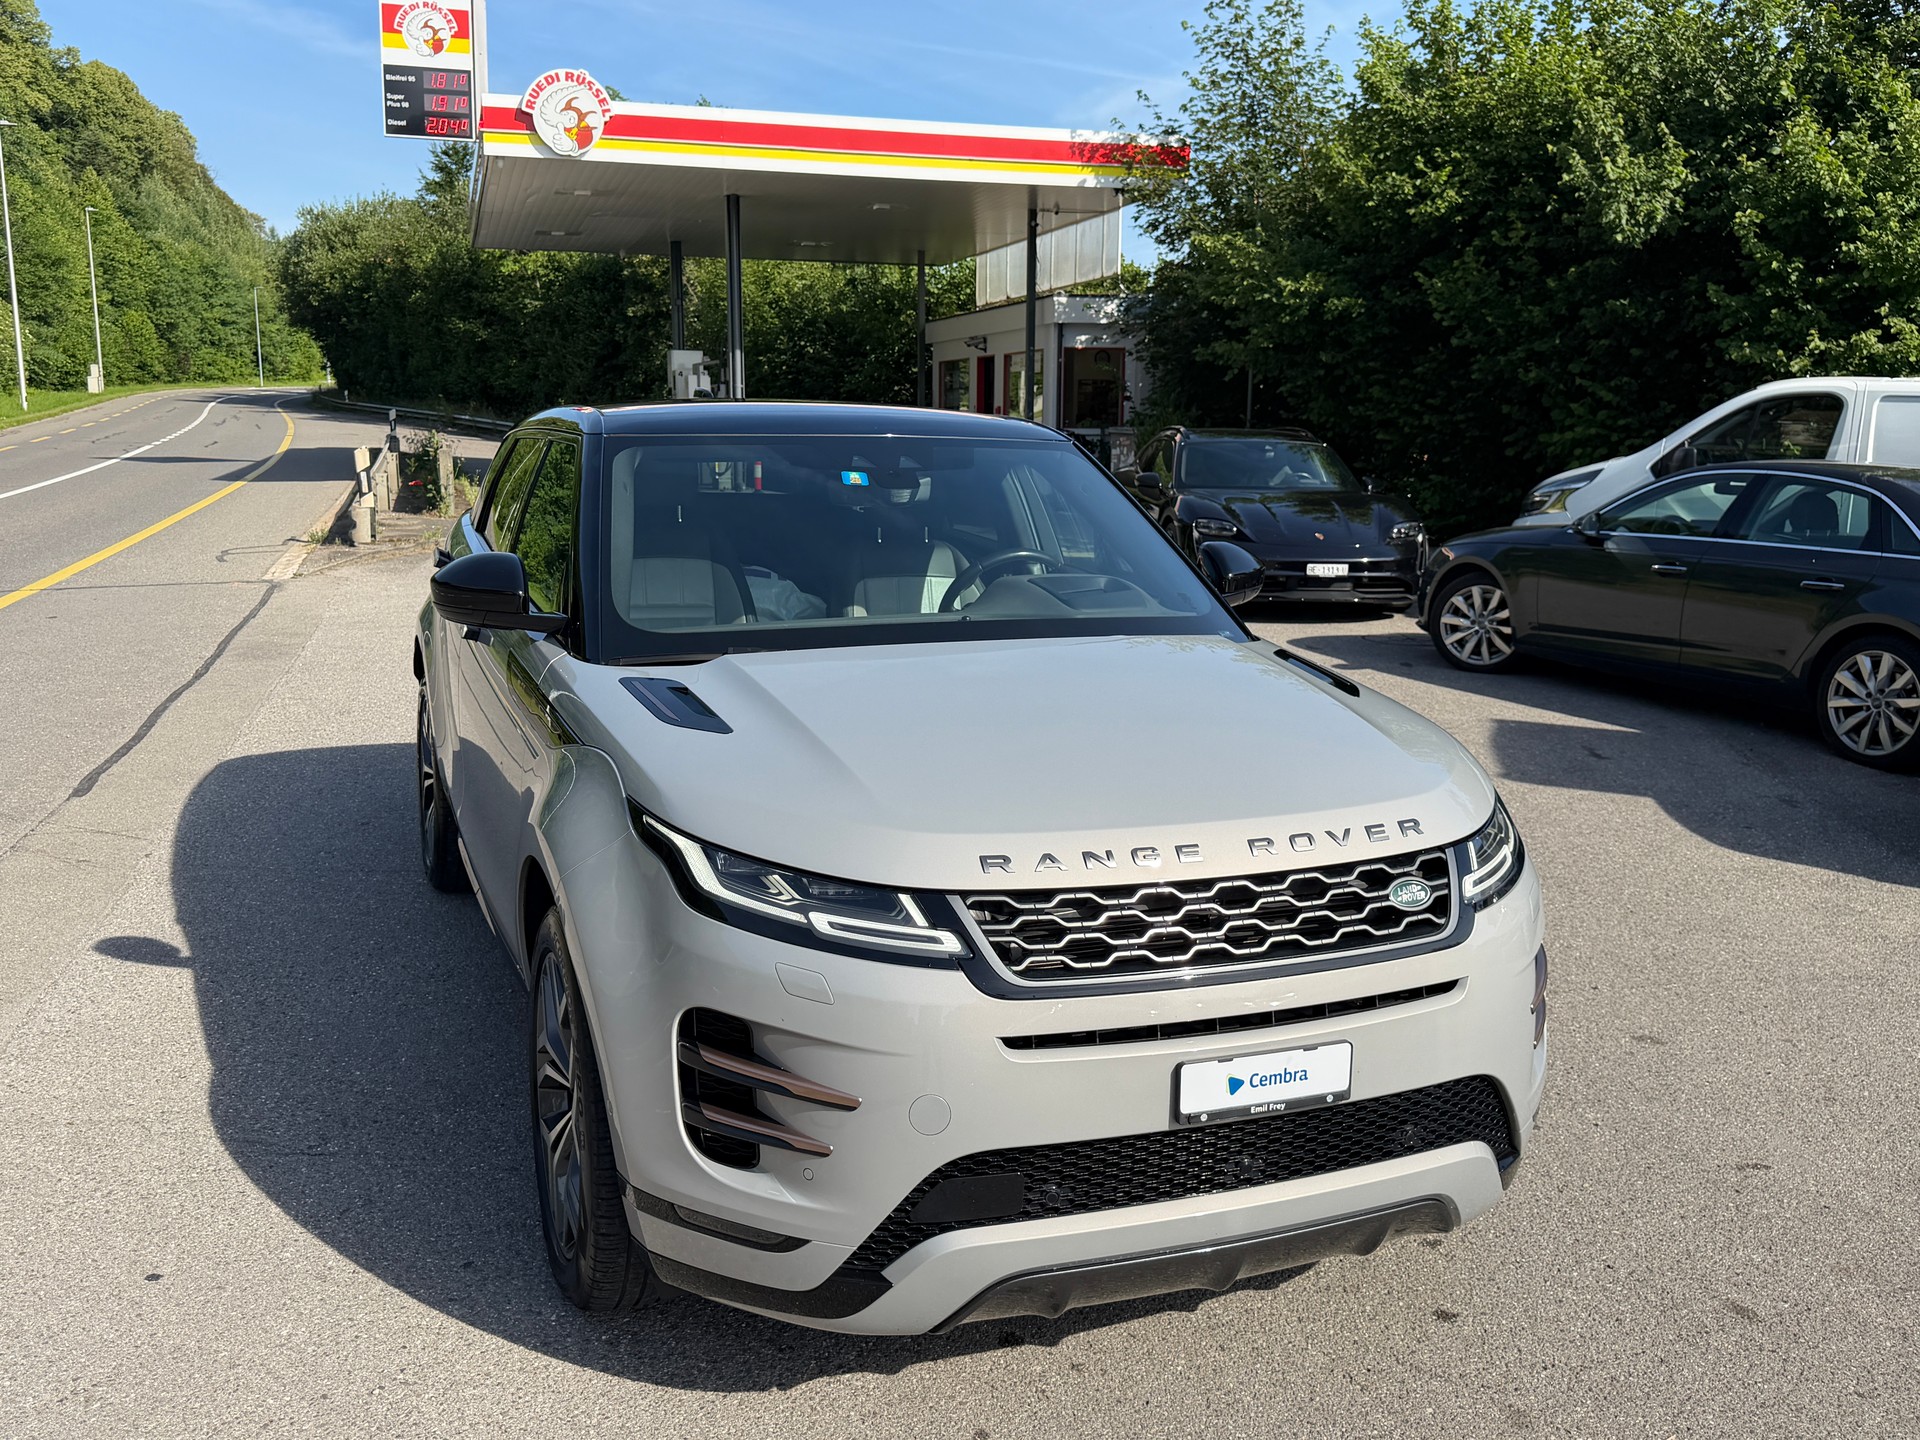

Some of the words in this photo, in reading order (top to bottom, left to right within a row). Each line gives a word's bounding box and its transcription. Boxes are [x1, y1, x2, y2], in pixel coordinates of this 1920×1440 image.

[396, 2, 420, 28] RUEDI
[422, 1, 456, 33] RÜSSEL
[385, 74, 407, 82] Bleifrei
[525, 72, 561, 111] RUEDI
[564, 71, 612, 118] RÜSSEL
[978, 843, 1204, 874] RANGE
[1247, 818, 1424, 857] ROVER
[1397, 884, 1418, 895] LAND
[1402, 891, 1425, 903] ROVER
[1250, 1067, 1309, 1088] Cembra
[1250, 1104, 1268, 1114] Emil
[1269, 1102, 1286, 1112] Frey
